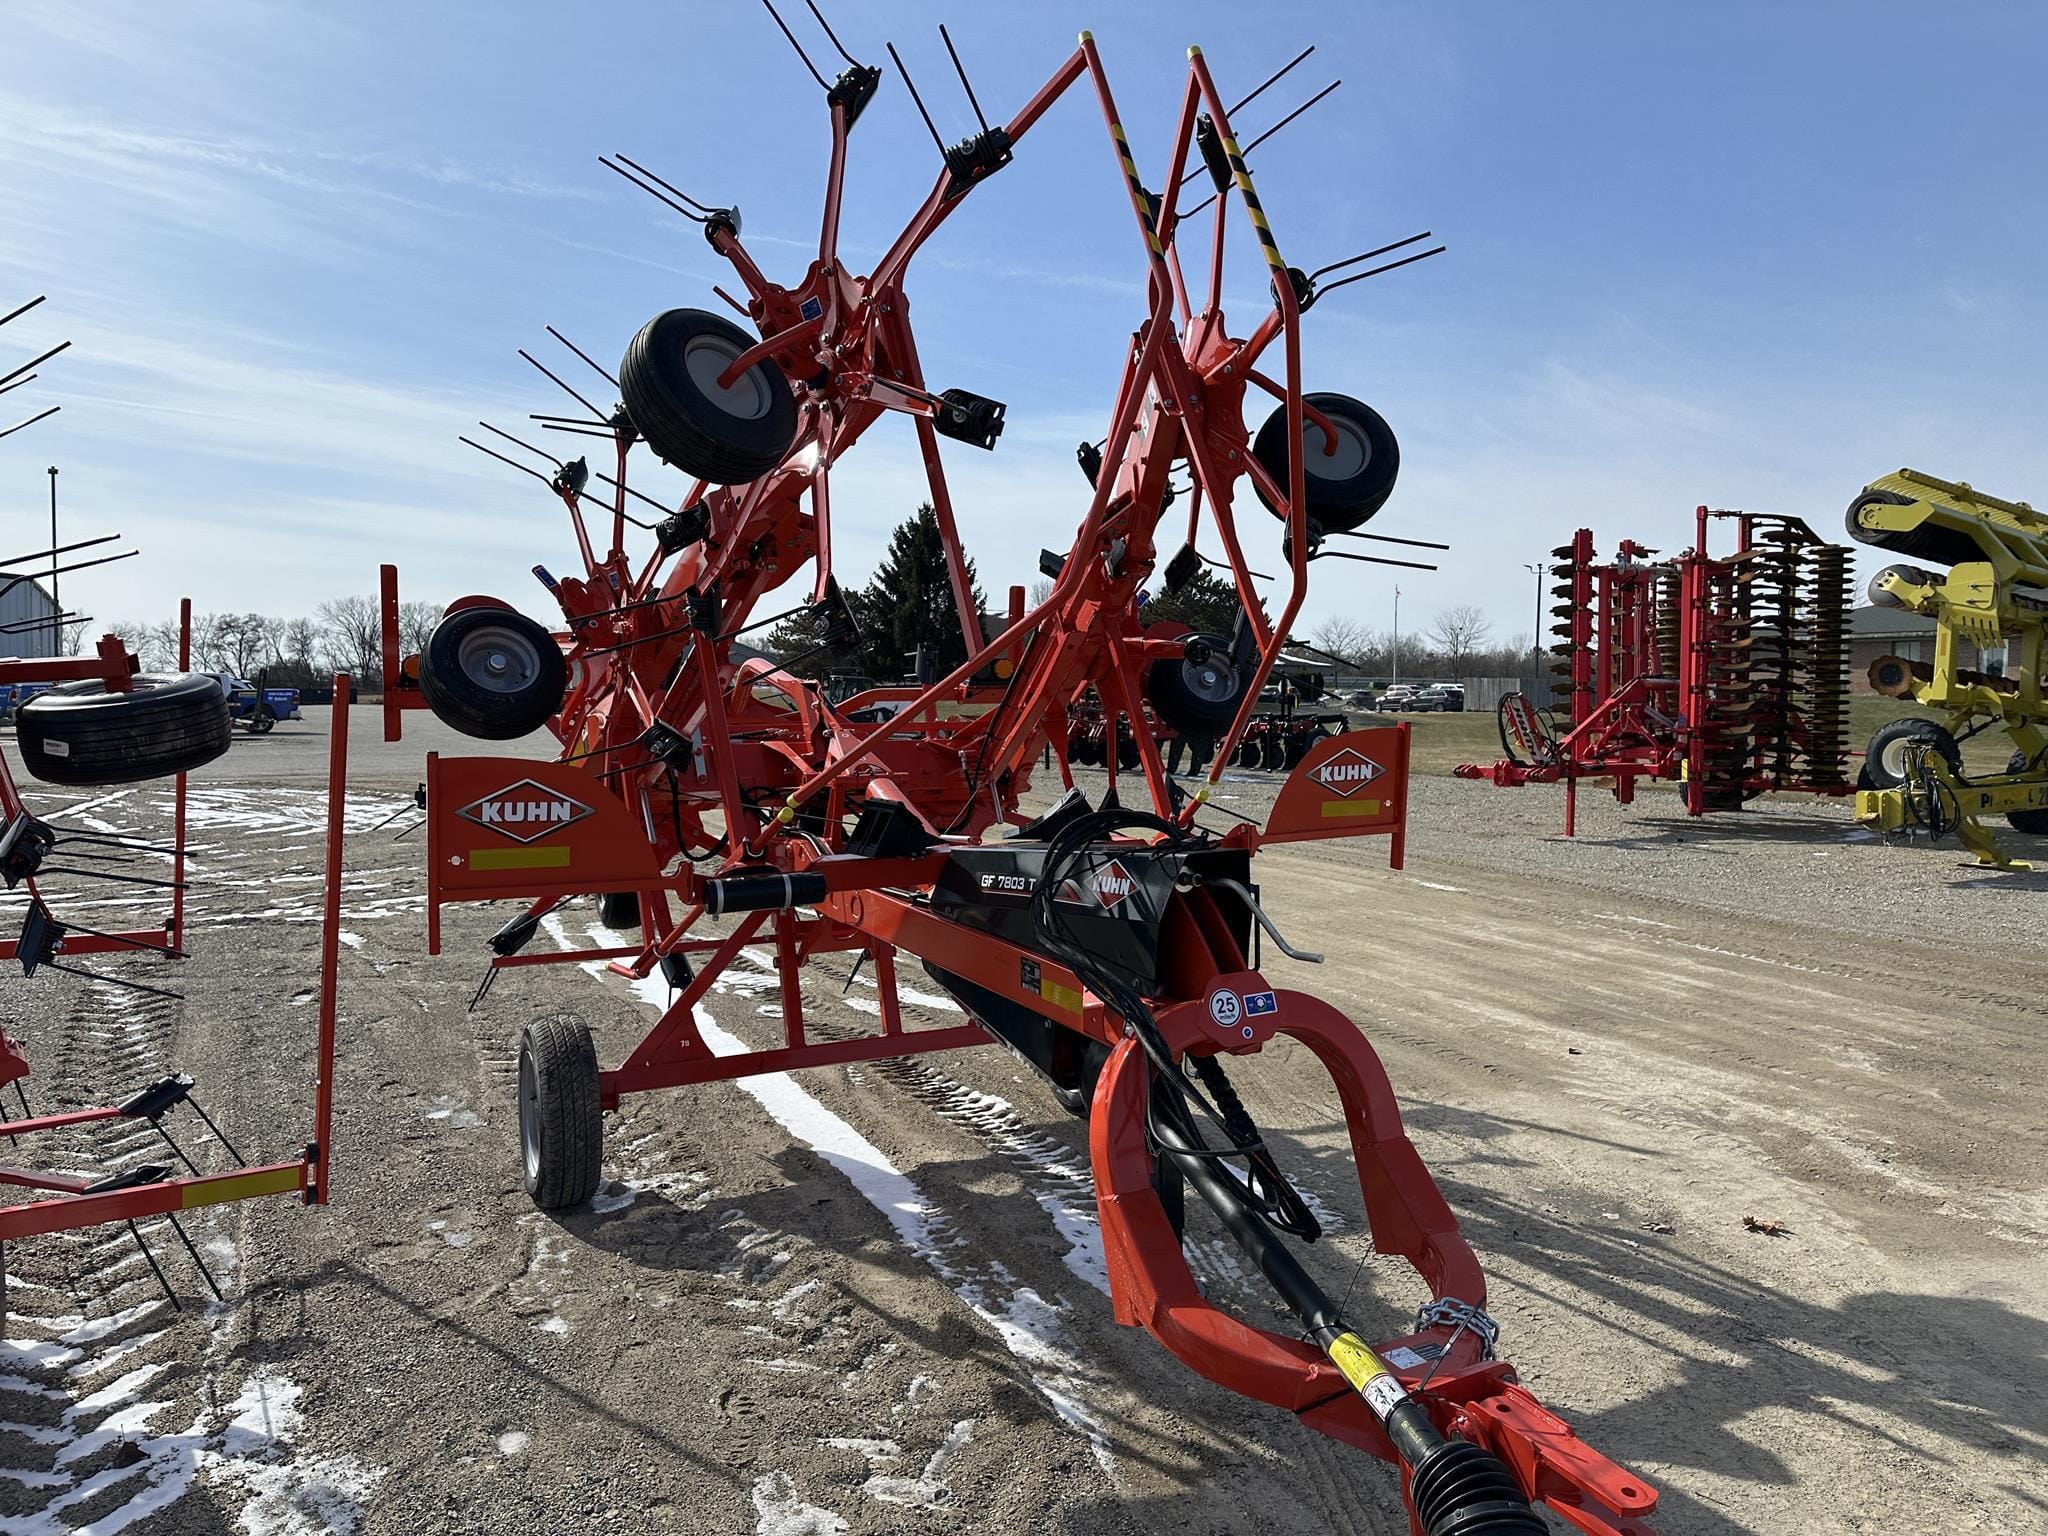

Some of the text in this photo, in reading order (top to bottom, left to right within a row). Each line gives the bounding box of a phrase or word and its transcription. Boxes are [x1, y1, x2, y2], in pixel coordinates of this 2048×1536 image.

[1320, 764, 1373, 782] KUHN
[481, 801, 571, 822] KUHN
[981, 874, 1037, 891] GF 7803 T
[1092, 875, 1131, 896] KUHN
[1215, 996, 1236, 1014] 25
